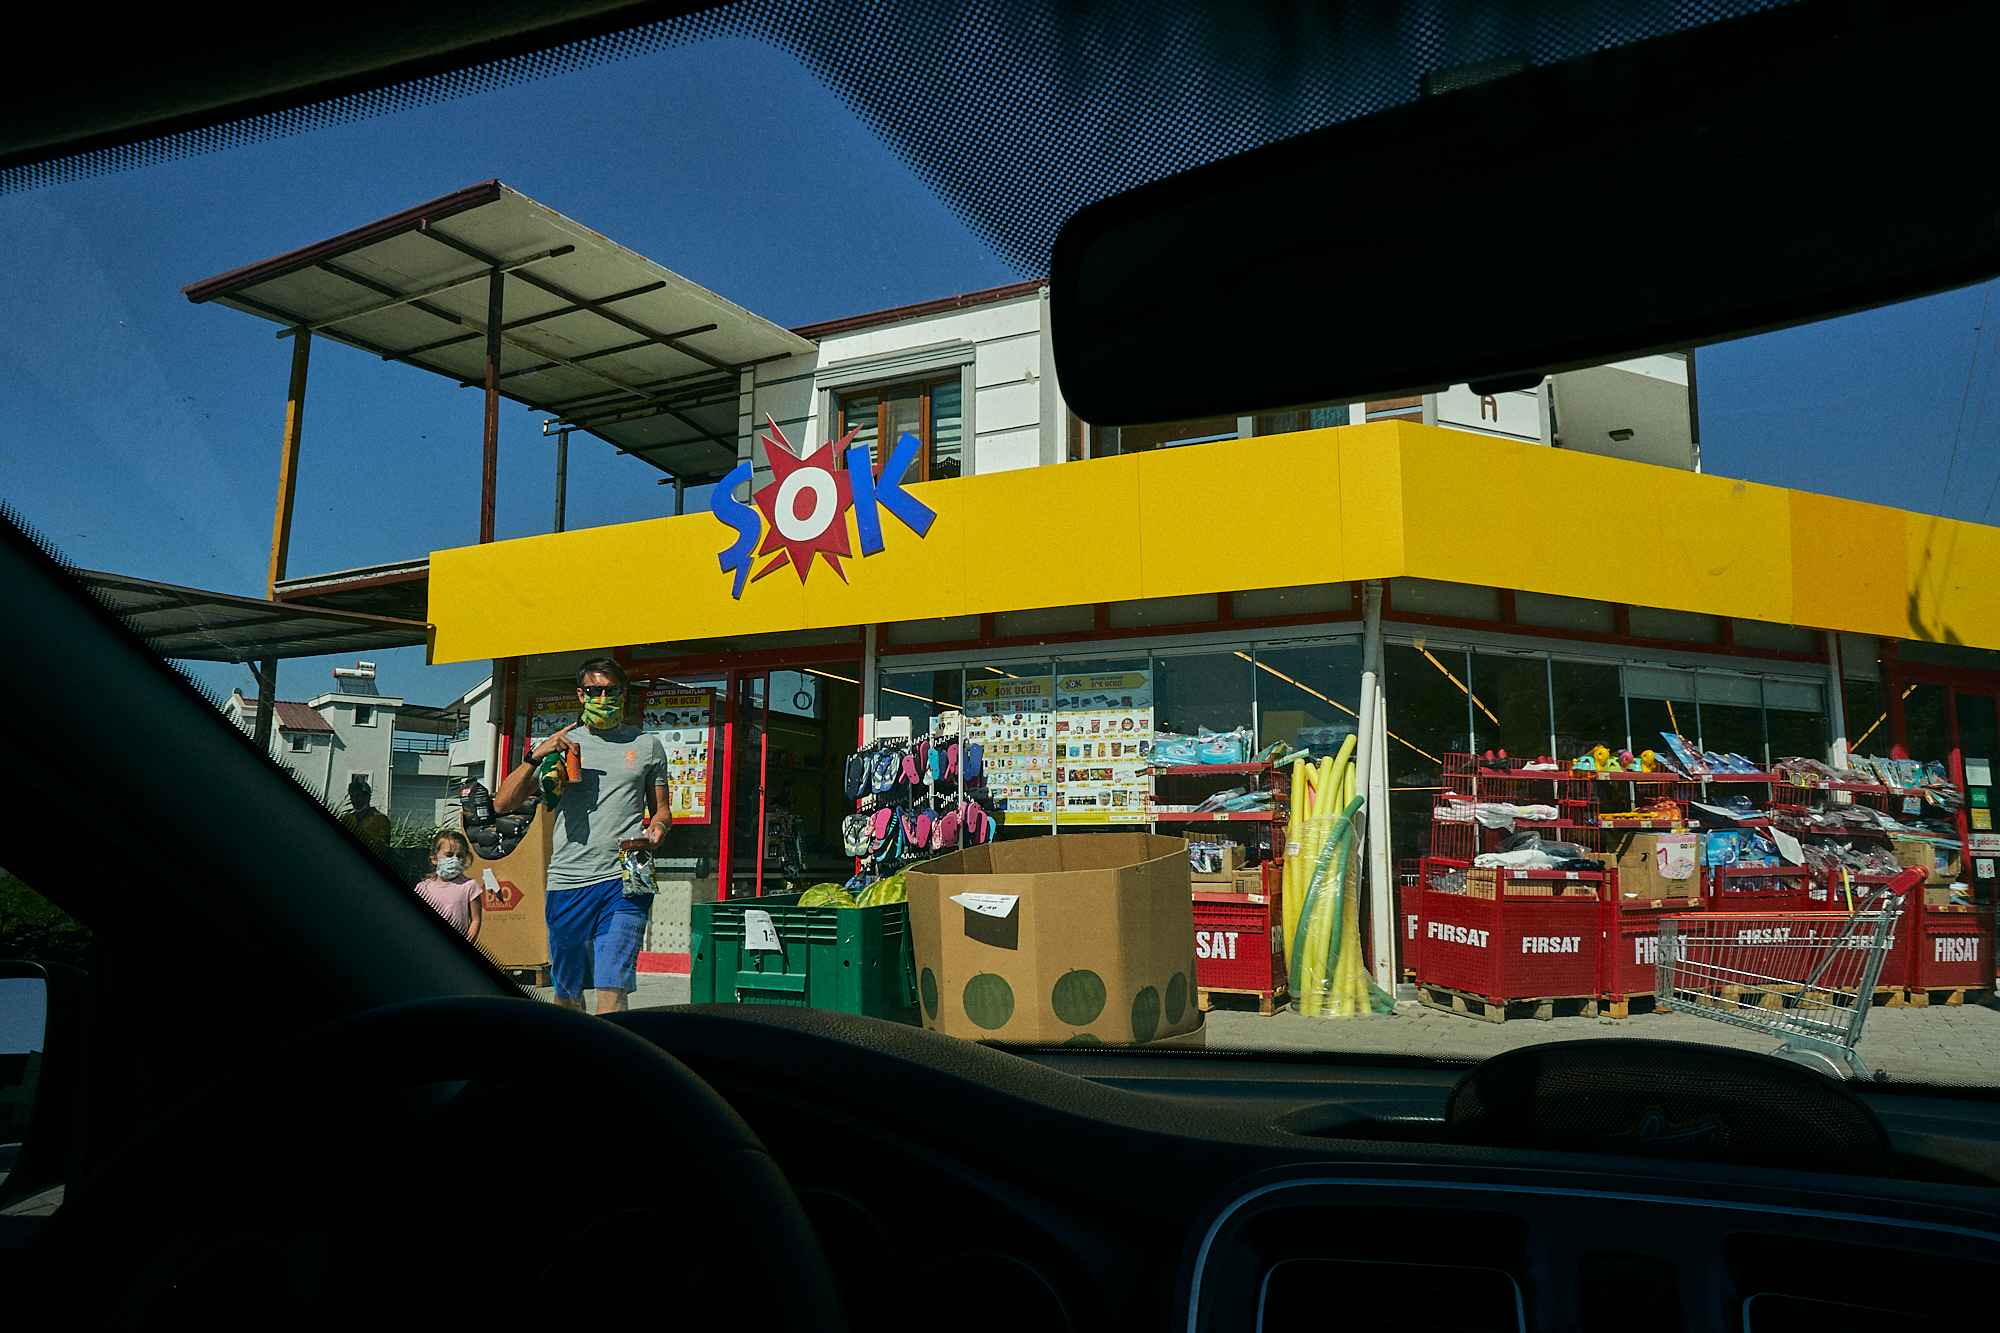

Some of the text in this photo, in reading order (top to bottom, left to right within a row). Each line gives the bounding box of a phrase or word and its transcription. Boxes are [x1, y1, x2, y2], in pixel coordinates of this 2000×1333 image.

[711, 431, 937, 600] ŞOK
[1014, 684, 1041, 695] UCUZ!
[680, 696, 701, 704] UCUZ!
[1427, 921, 1490, 948] FIRSAT
[1738, 927, 1791, 945] FIRSAT
[1521, 936, 1582, 954] FIRSAT
[1934, 937, 1980, 962] FIRSAT
